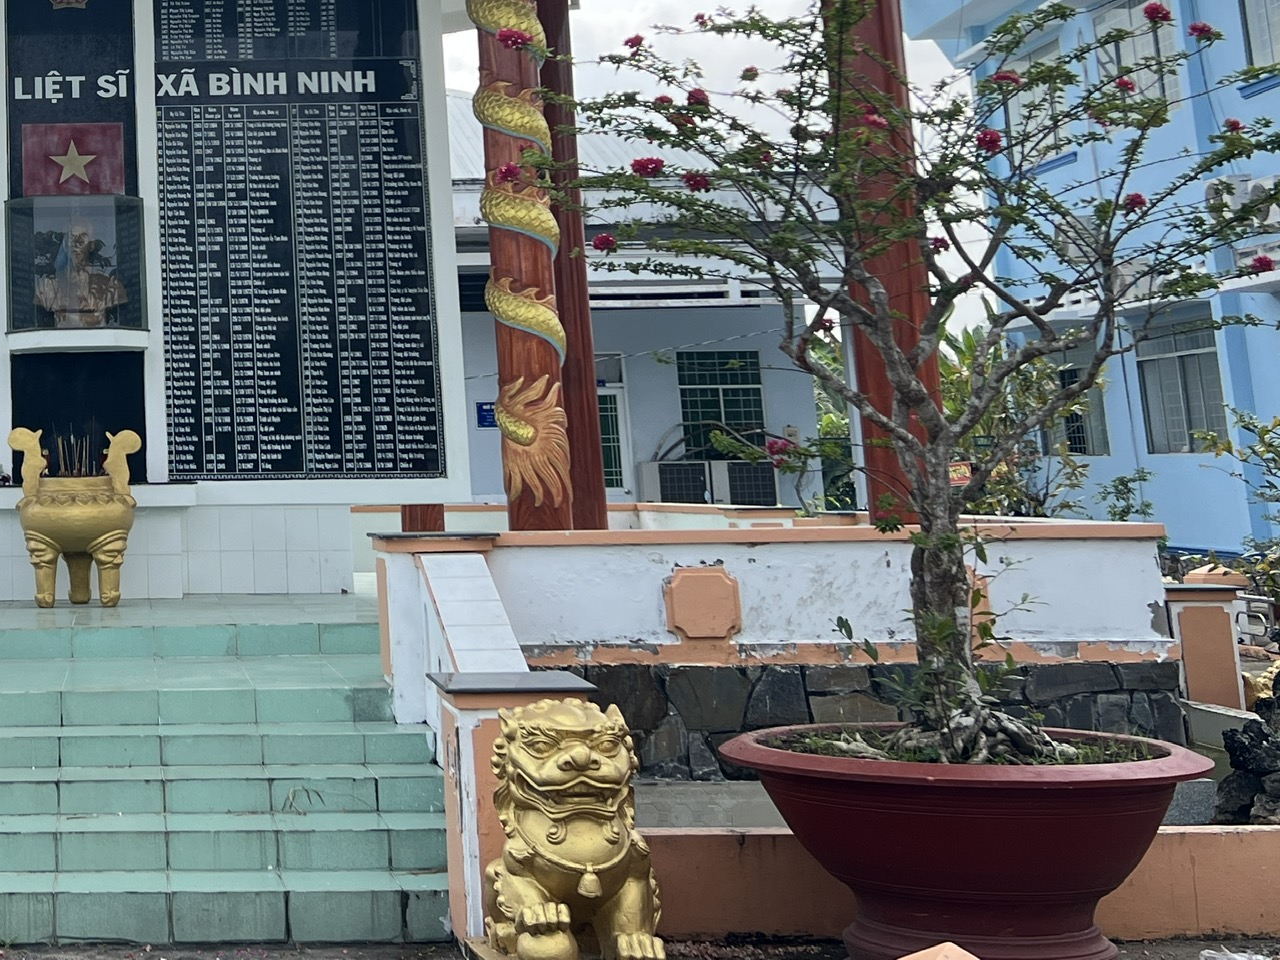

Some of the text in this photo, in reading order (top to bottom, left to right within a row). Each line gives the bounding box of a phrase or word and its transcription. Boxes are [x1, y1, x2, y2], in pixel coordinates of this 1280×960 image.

[14, 69, 130, 104] LIỆT SĨ
[157, 67, 376, 97] XÃ BÌNH NINH
